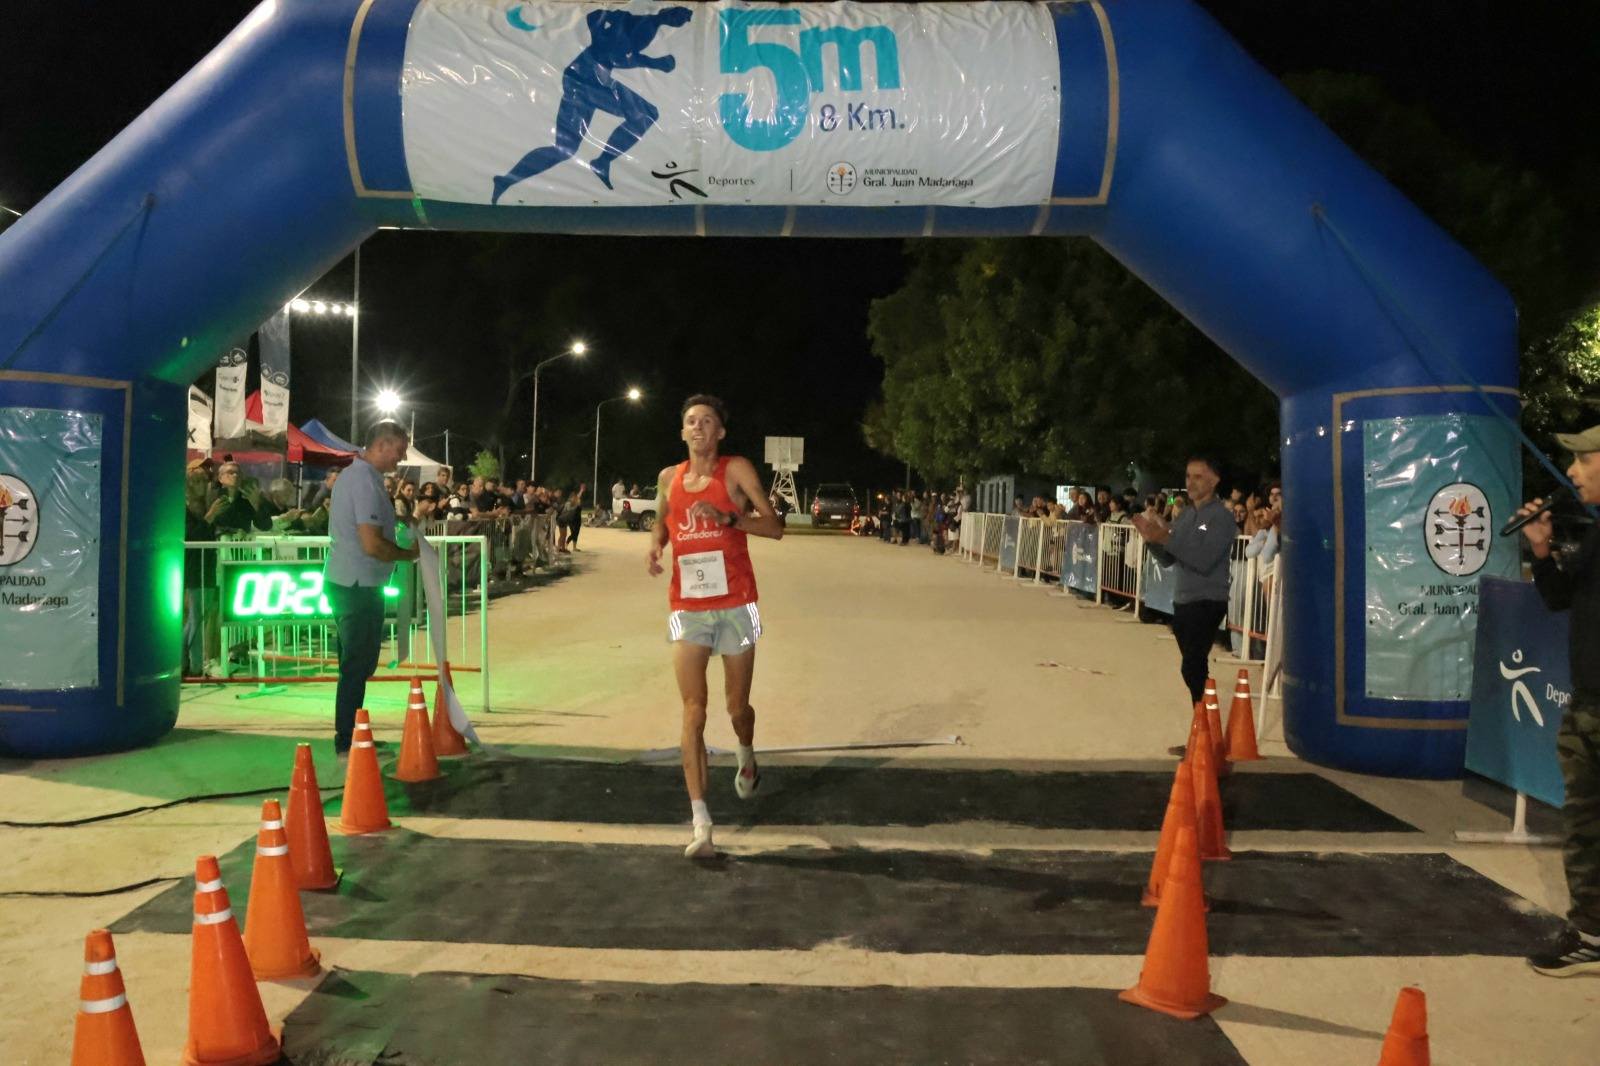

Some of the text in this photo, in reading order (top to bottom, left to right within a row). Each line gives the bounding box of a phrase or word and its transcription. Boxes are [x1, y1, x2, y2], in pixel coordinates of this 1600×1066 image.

[820, 103, 905, 131] 8 Km.
[708, 176, 754, 186] Deportes
[863, 177, 887, 187] Gral.
[891, 177, 914, 187] Juan
[696, 569, 704, 581] 9
